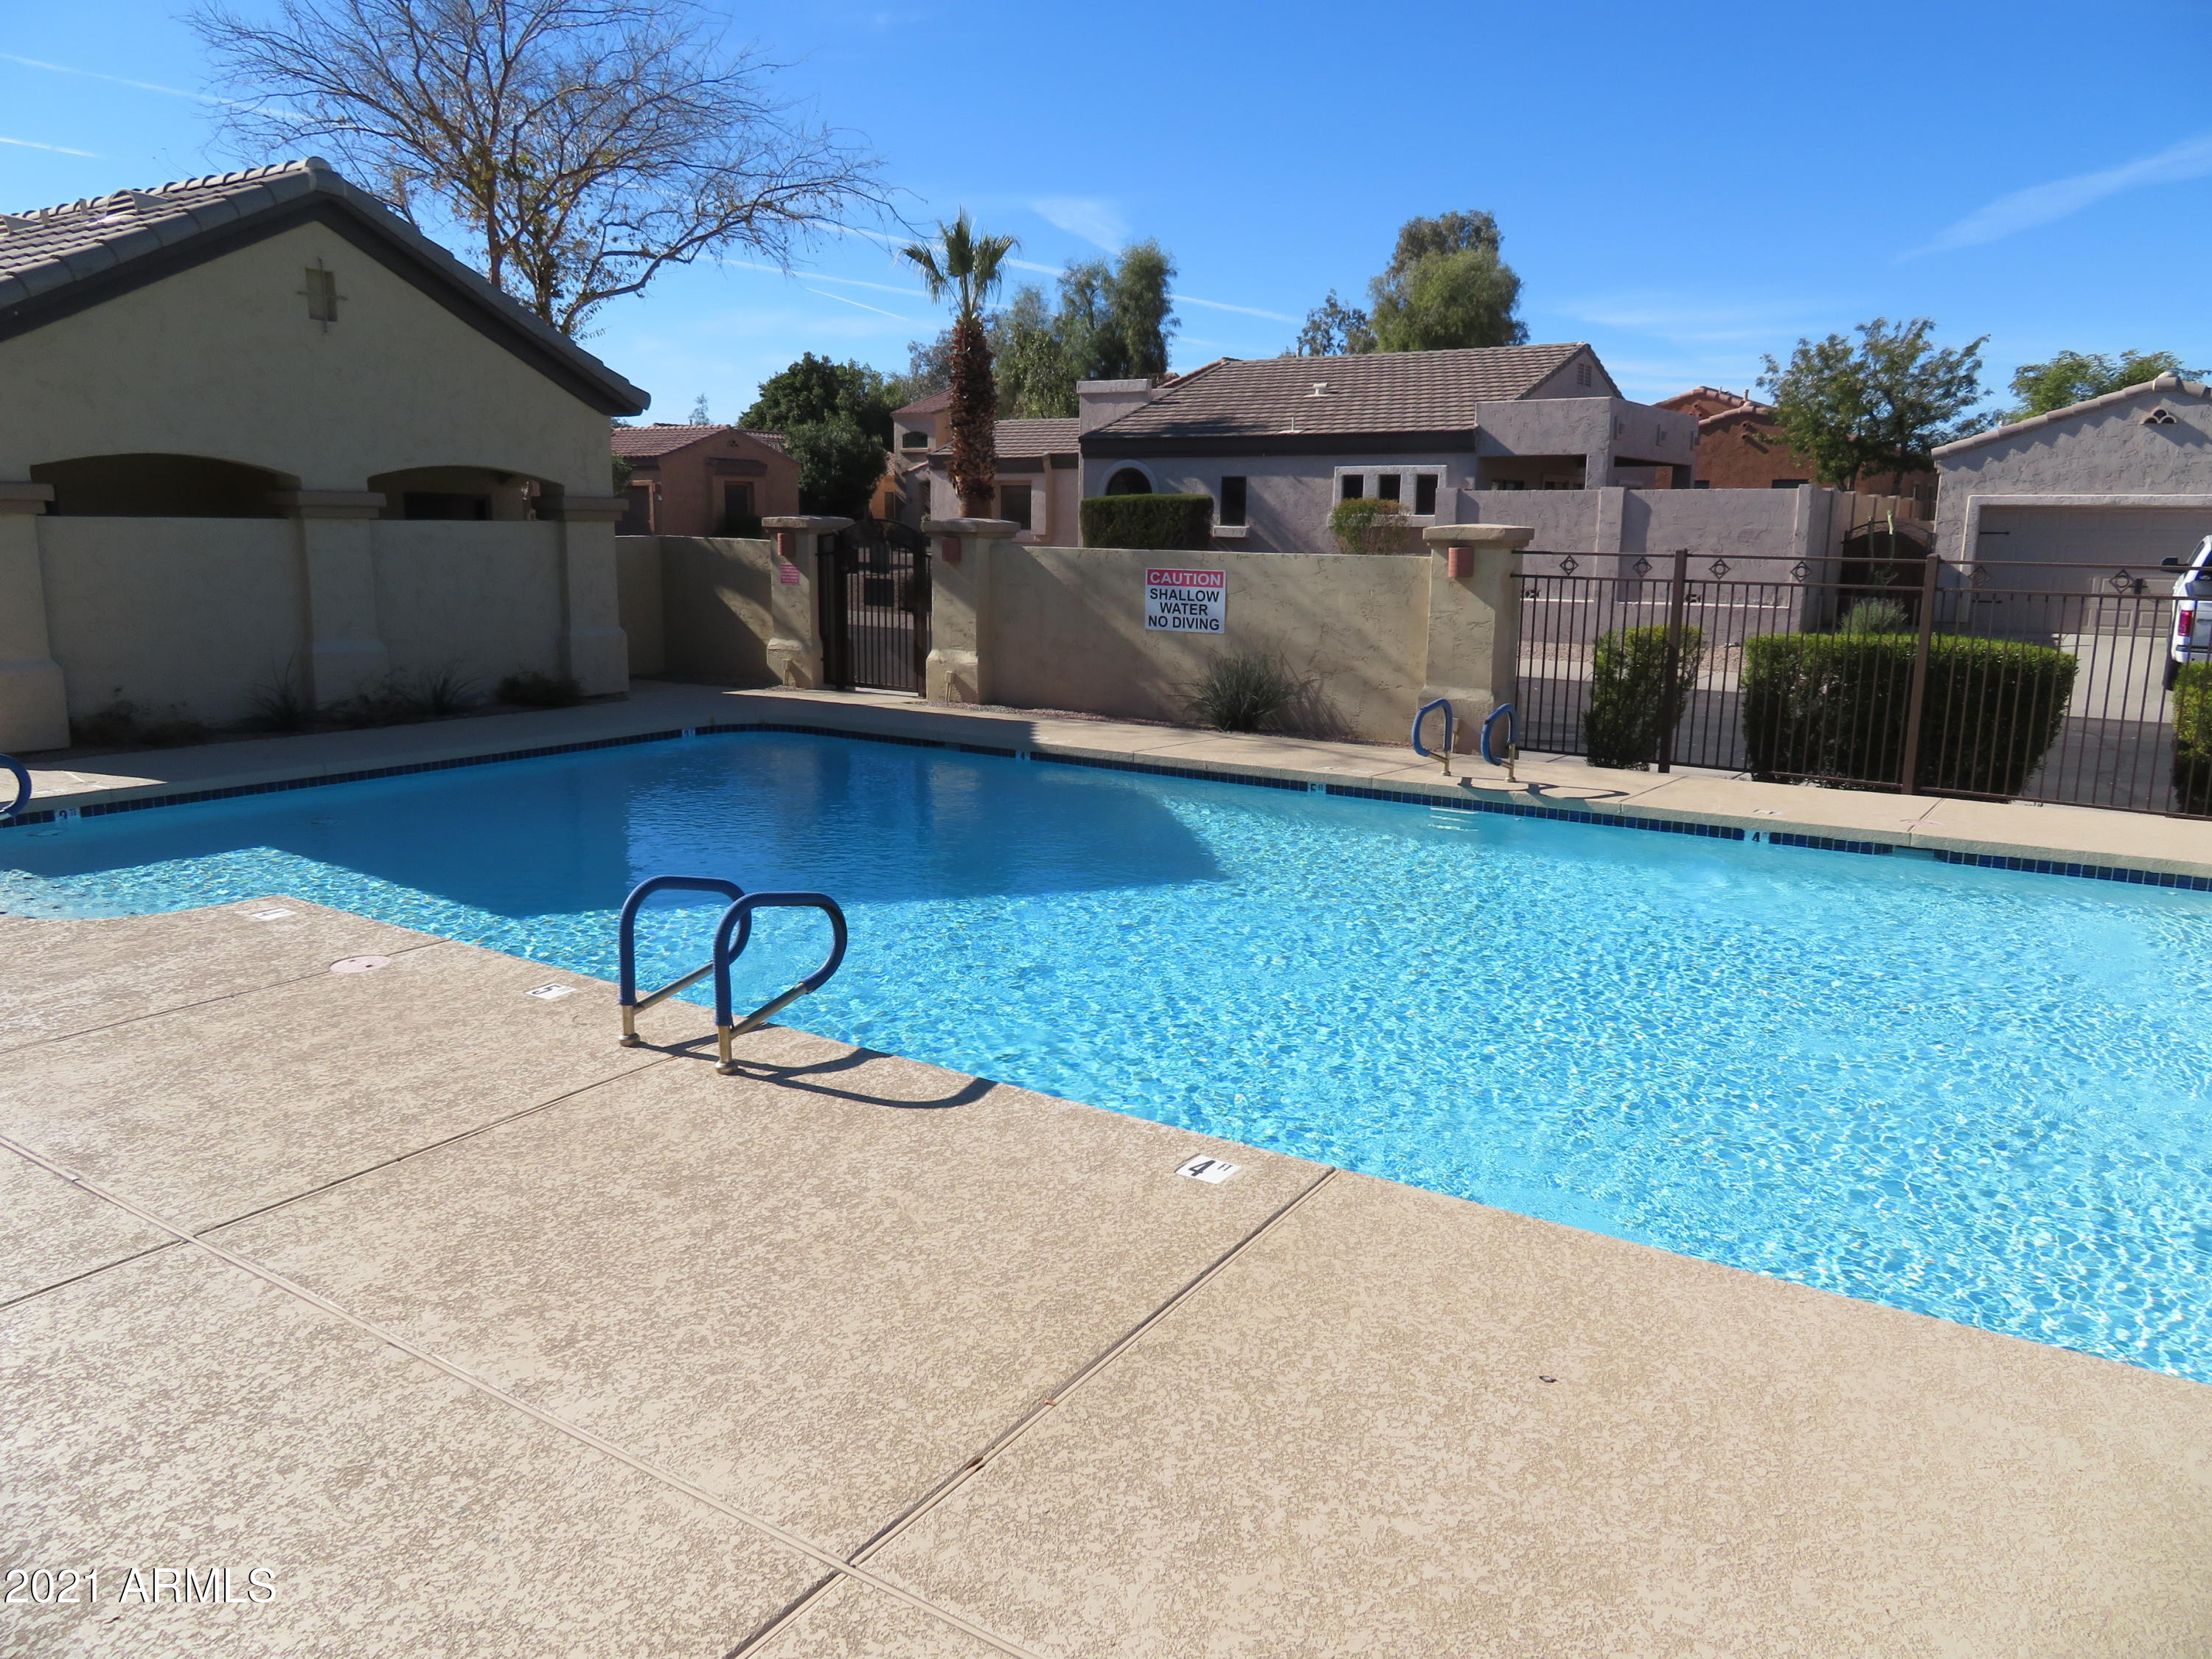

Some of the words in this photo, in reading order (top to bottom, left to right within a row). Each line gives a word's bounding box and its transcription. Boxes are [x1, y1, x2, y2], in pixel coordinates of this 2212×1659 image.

[1150, 571, 1220, 586] CAUTION
[1150, 588, 1220, 602] SHALLOW
[1160, 602, 1208, 616] WATER
[1148, 616, 1168, 627] NO
[1172, 616, 1220, 630] DIVING
[532, 984, 562, 995] 5
[1188, 1160, 1216, 1177] 4
